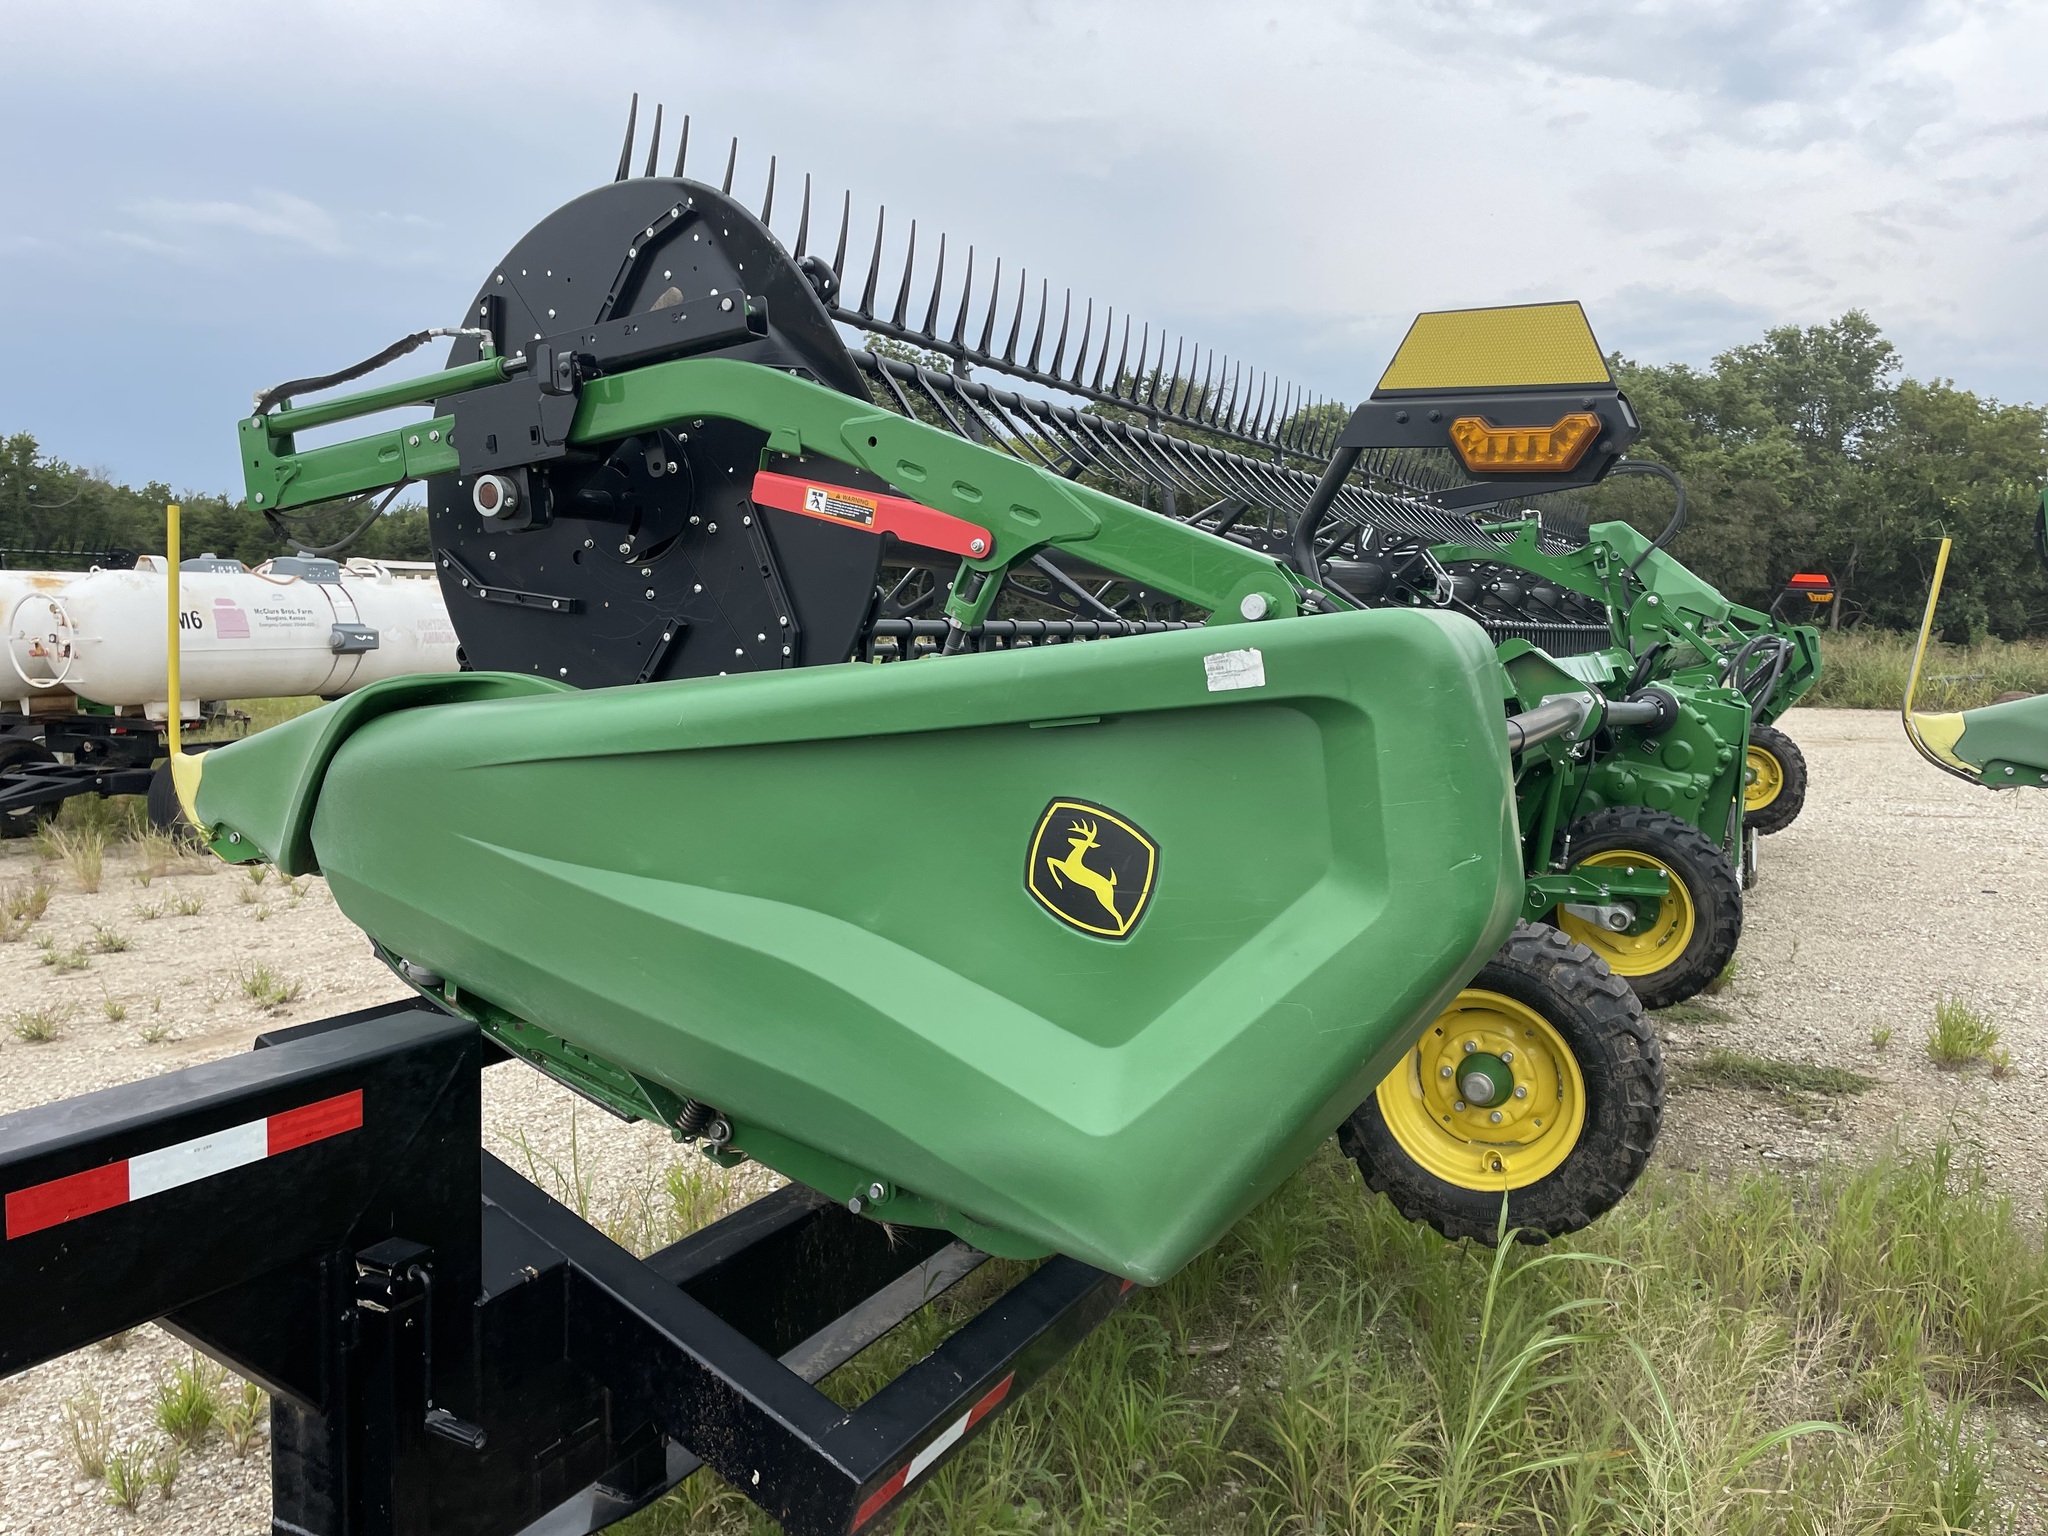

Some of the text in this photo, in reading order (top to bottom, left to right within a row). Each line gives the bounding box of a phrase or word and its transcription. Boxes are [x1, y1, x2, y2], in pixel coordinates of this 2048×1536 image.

[671, 312, 679, 324] 3
[623, 324, 631, 336] 2
[581, 335, 586, 346] 1
[842, 494, 869, 506] WARNING
